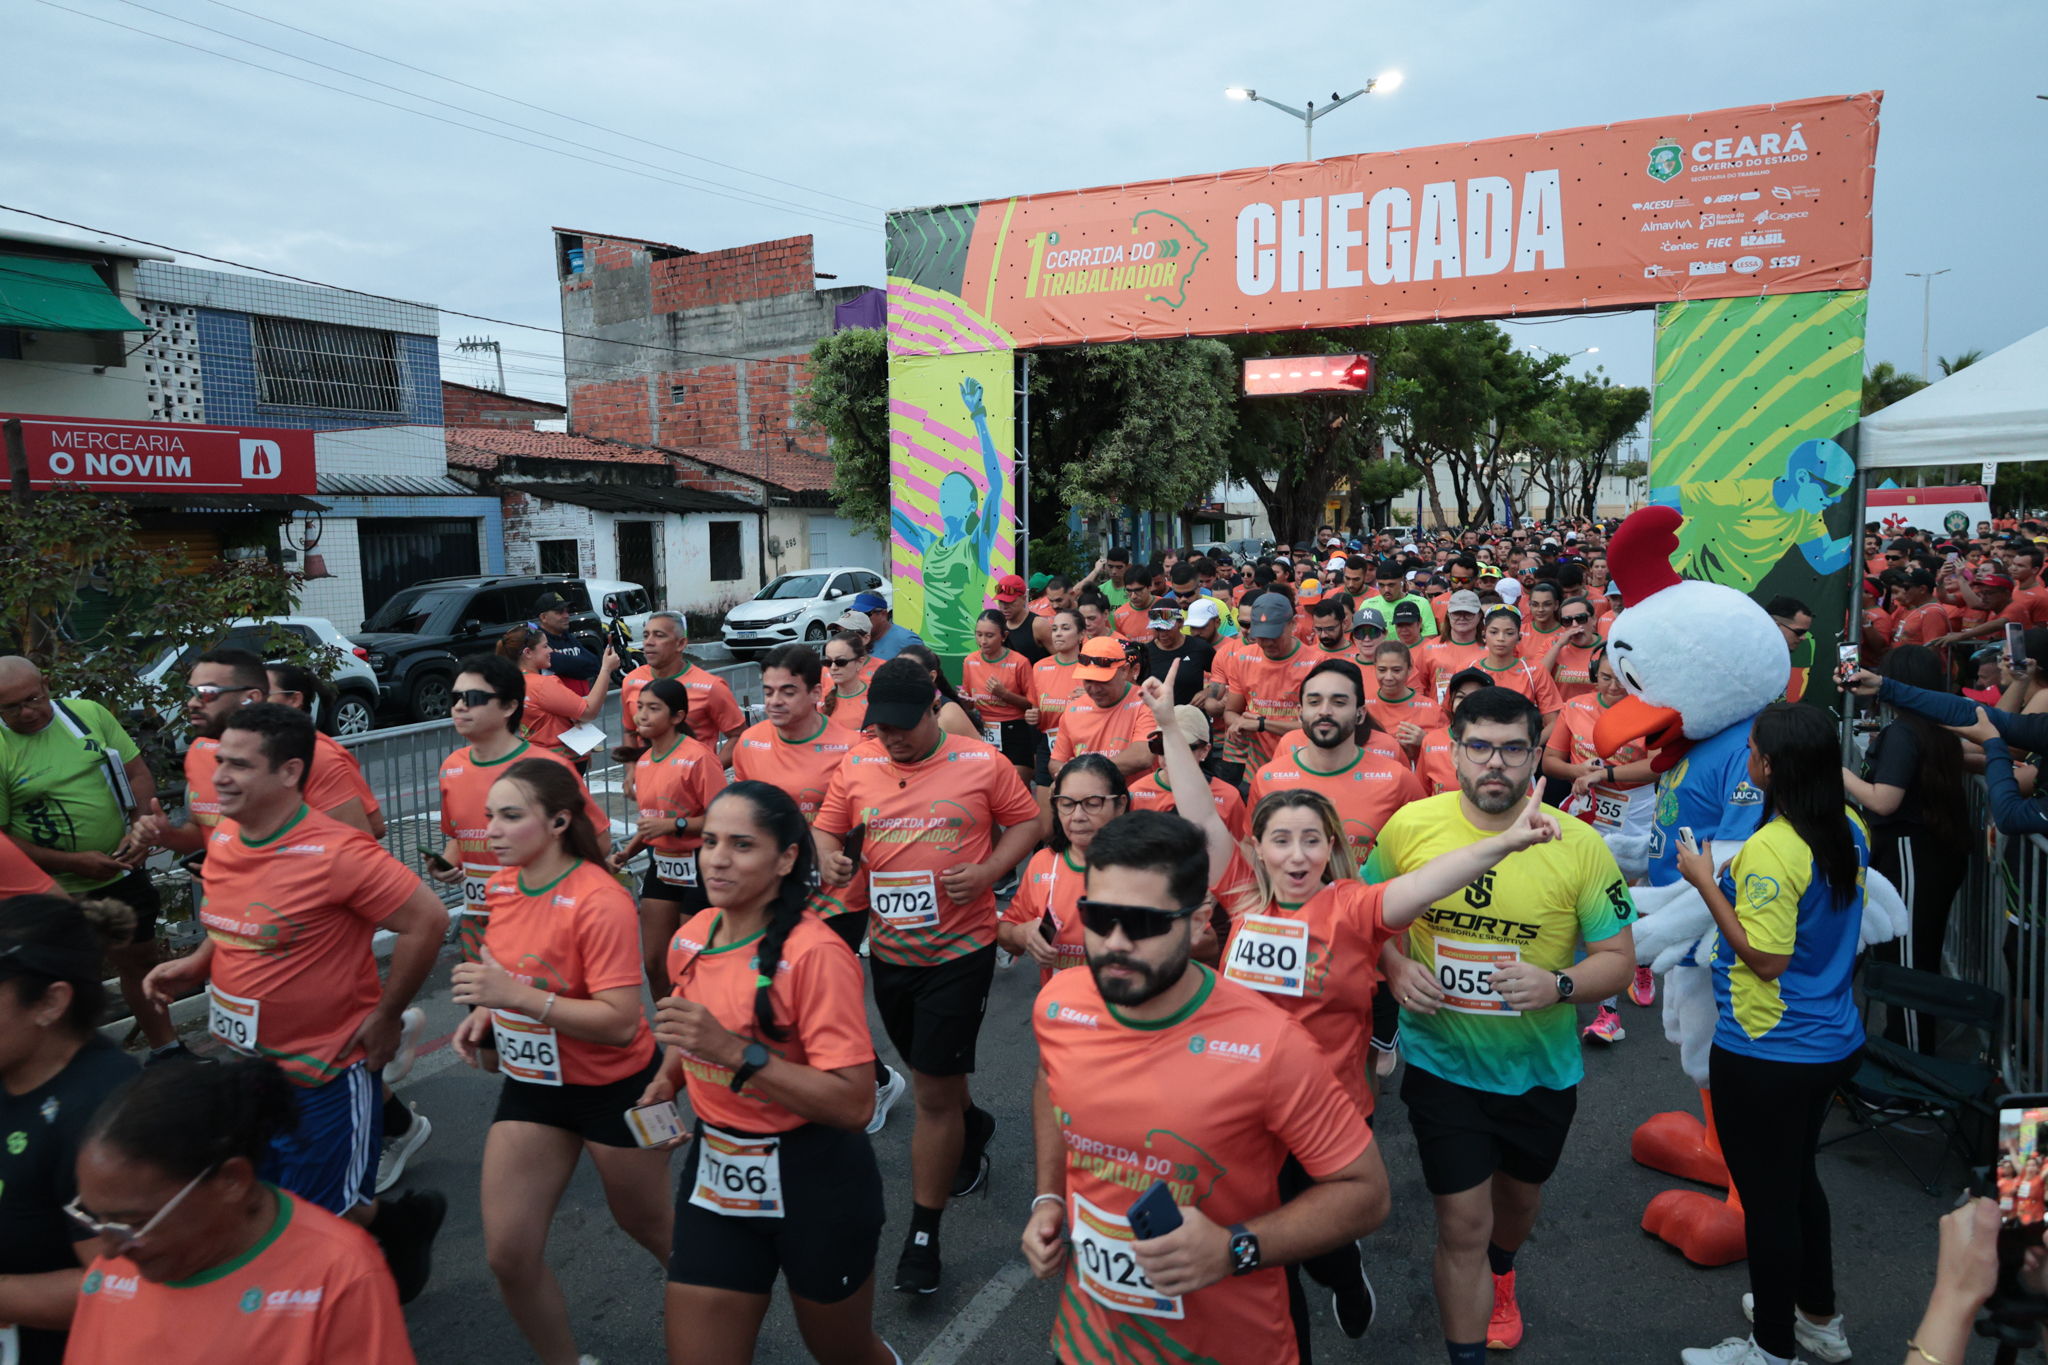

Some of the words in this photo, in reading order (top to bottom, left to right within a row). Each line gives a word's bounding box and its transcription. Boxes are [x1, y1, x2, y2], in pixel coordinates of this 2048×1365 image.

[1691, 123, 1808, 162] CEARÁ
[1691, 160, 1743, 172] GOVERNO
[1746, 158, 1762, 167] DO
[1765, 154, 1808, 165] ESTADO
[1691, 174, 1726, 182] SECRETARIA
[1737, 170, 1770, 178] TRABALHO
[1642, 200, 1674, 210] ACESU
[1769, 212, 1809, 221] Cagece
[1236, 169, 1565, 296] CHEGADA
[1740, 233, 1786, 246] BRASIL
[1664, 242, 1699, 251] Centec
[1046, 245, 1124, 269] CORRIDA
[1130, 242, 1156, 261] DO
[1737, 260, 1758, 268] LESSA
[1042, 262, 1178, 297] TRABALHADOR
[52, 430, 184, 452] MERCEARIA
[49, 452, 75, 475] O
[85, 453, 192, 477] NOVIM
[1559, 676, 1591, 684] TRABALH
[1253, 707, 1300, 716] TRABALHADO
[751, 740, 771, 748] CEARÁ
[1374, 748, 1394, 757] CEARÁ
[1730, 792, 1758, 800] IJUCA
[191, 802, 220, 813] CORRI
[800, 802, 814, 810] DO
[870, 818, 924, 828] CORRIDA
[928, 817, 946, 828] DO
[455, 829, 487, 838] CORRID
[869, 829, 959, 843] TRABALHADOR
[659, 860, 690, 876] 0701
[466, 882, 486, 900] 03
[877, 891, 933, 913] 0702
[1422, 908, 1541, 939] SPORTS
[1428, 923, 1477, 938] ASSESSORIA
[1480, 933, 1529, 946] ESPORTIVA
[1055, 944, 1084, 954] RRID
[1235, 938, 1297, 971] 1480
[1442, 950, 1489, 960] CORREDOR
[1440, 965, 1502, 995] 055
[1061, 1007, 1098, 1027] CEARÁ
[1209, 1040, 1261, 1058] CEARÁ
[1063, 1130, 1139, 1166] CORRIDA
[1145, 1155, 1171, 1175] DO
[705, 1154, 767, 1194] 1766
[1072, 1153, 1194, 1205] RABALHAOR
